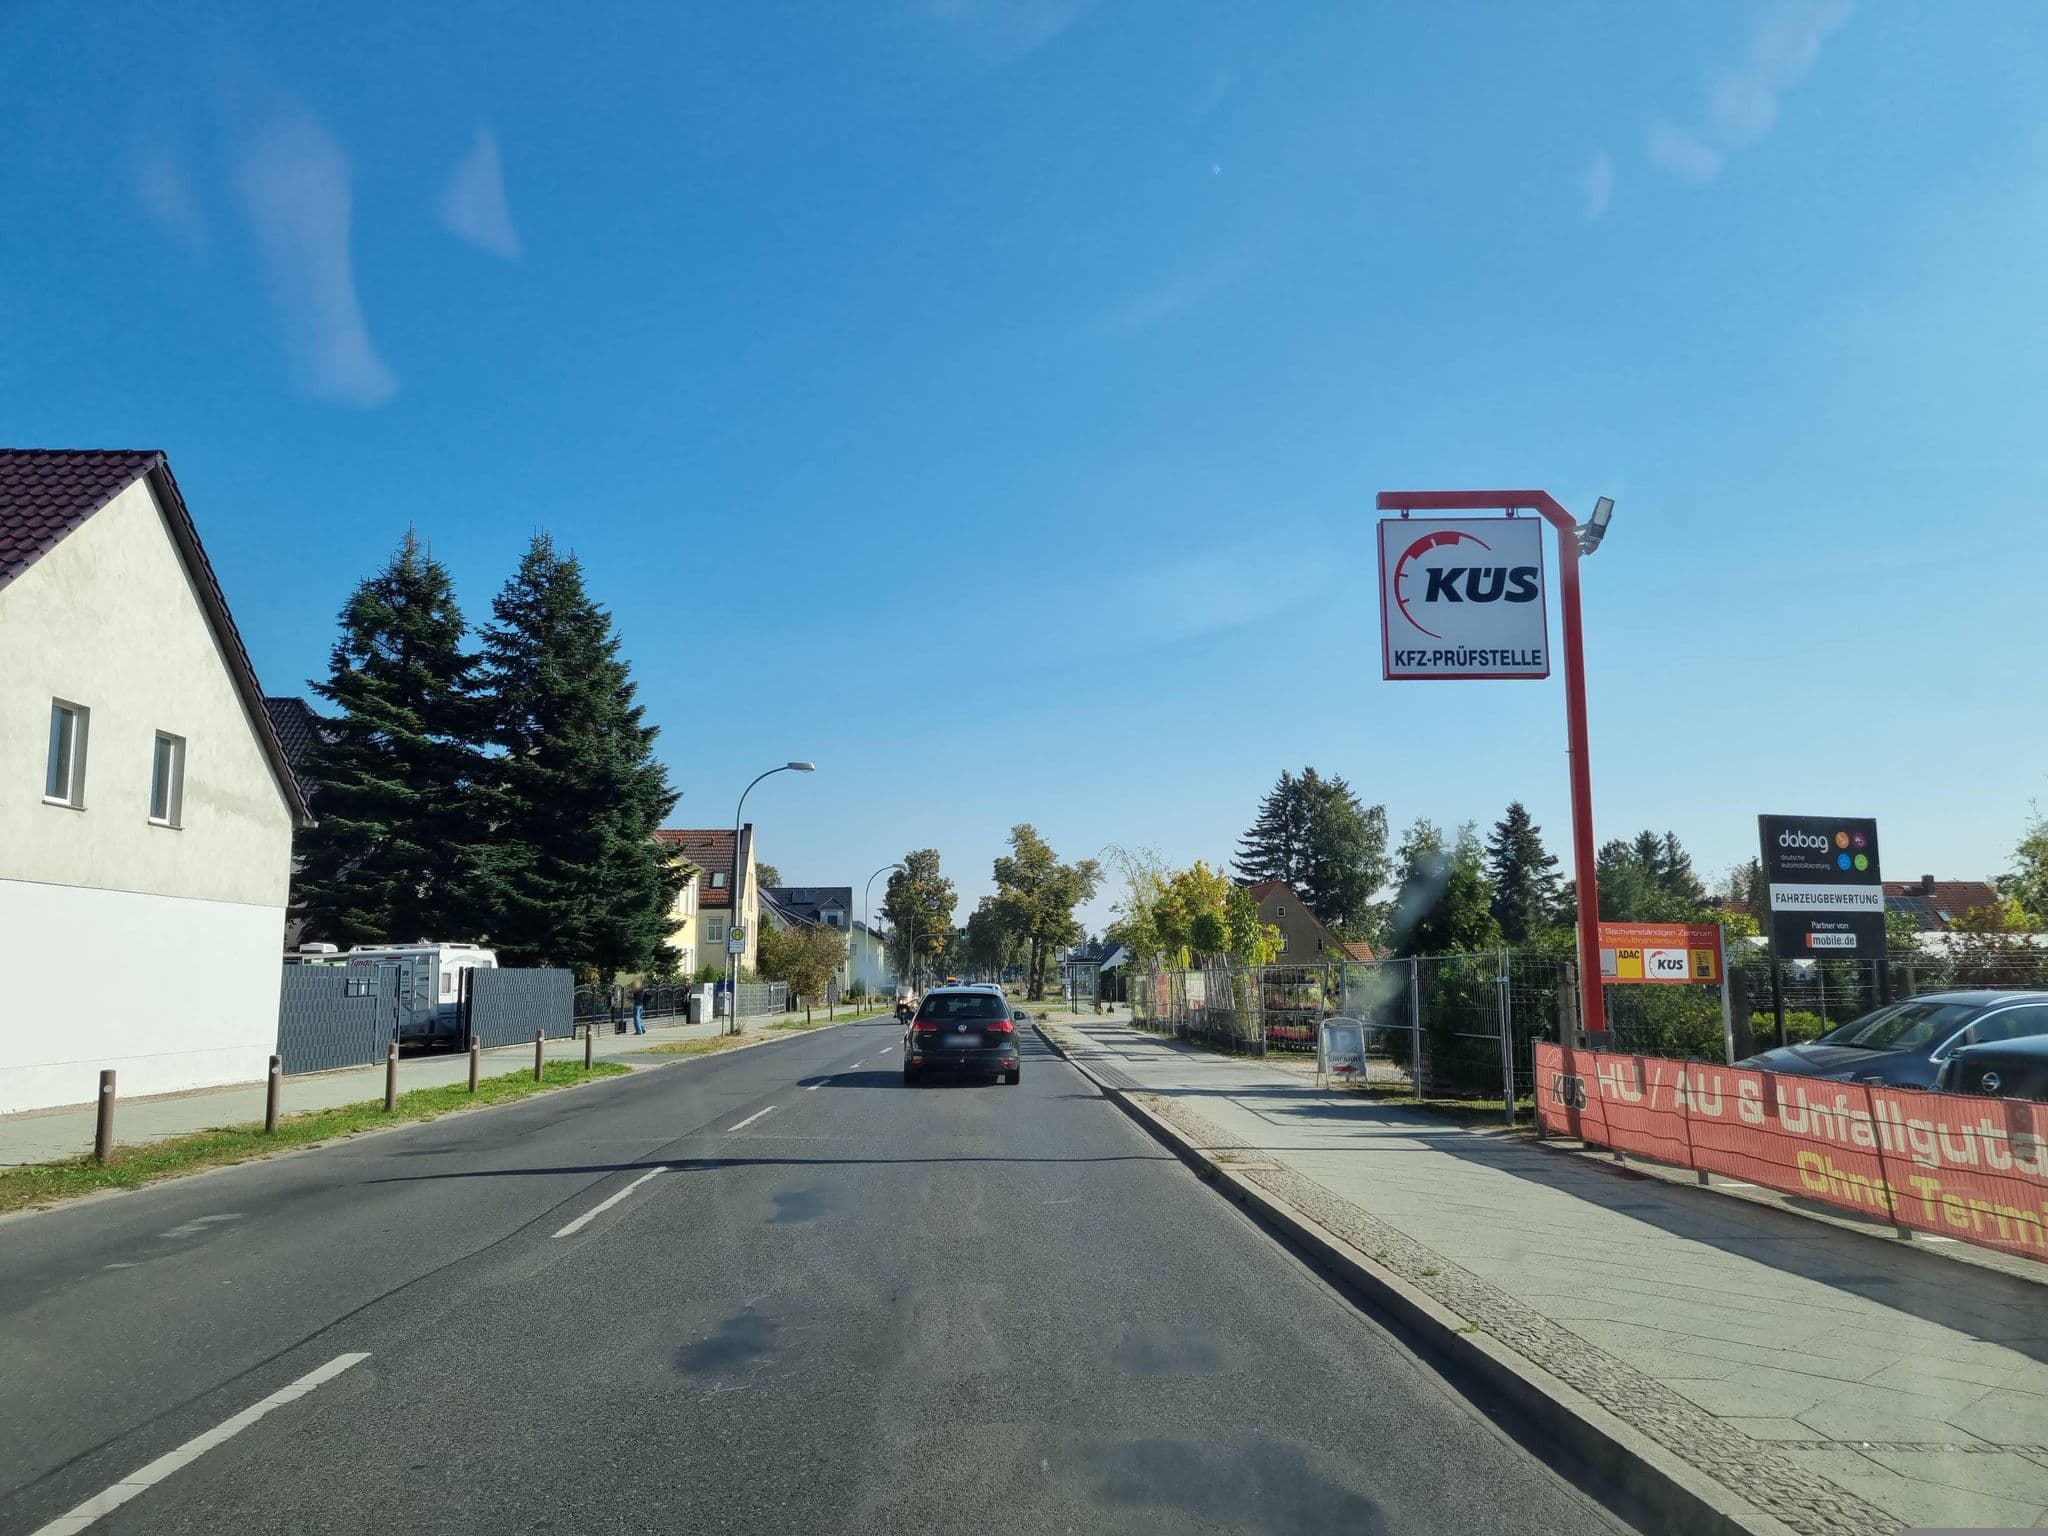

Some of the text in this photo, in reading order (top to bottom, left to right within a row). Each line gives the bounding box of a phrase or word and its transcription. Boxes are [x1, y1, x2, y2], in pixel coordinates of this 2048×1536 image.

[1425, 566, 1539, 603] KÜS
[1394, 646, 1543, 667] KFZ-PRÜFSTELLE
[1779, 829, 1829, 854] dabag
[1775, 892, 1879, 905] FAHRZEUGBEWERTUNG
[1811, 921, 1849, 930] Partner von
[1678, 929, 1713, 937] Zentrum
[1813, 934, 1855, 946] mobile.de
[1618, 950, 1640, 960] ADAC
[350, 958, 373, 968] Tango
[1596, 1062, 1642, 1102] HU
[1674, 1070, 1724, 1116] AU
[1737, 1079, 1765, 1126] &
[1796, 1150, 1899, 1212] Ohne
